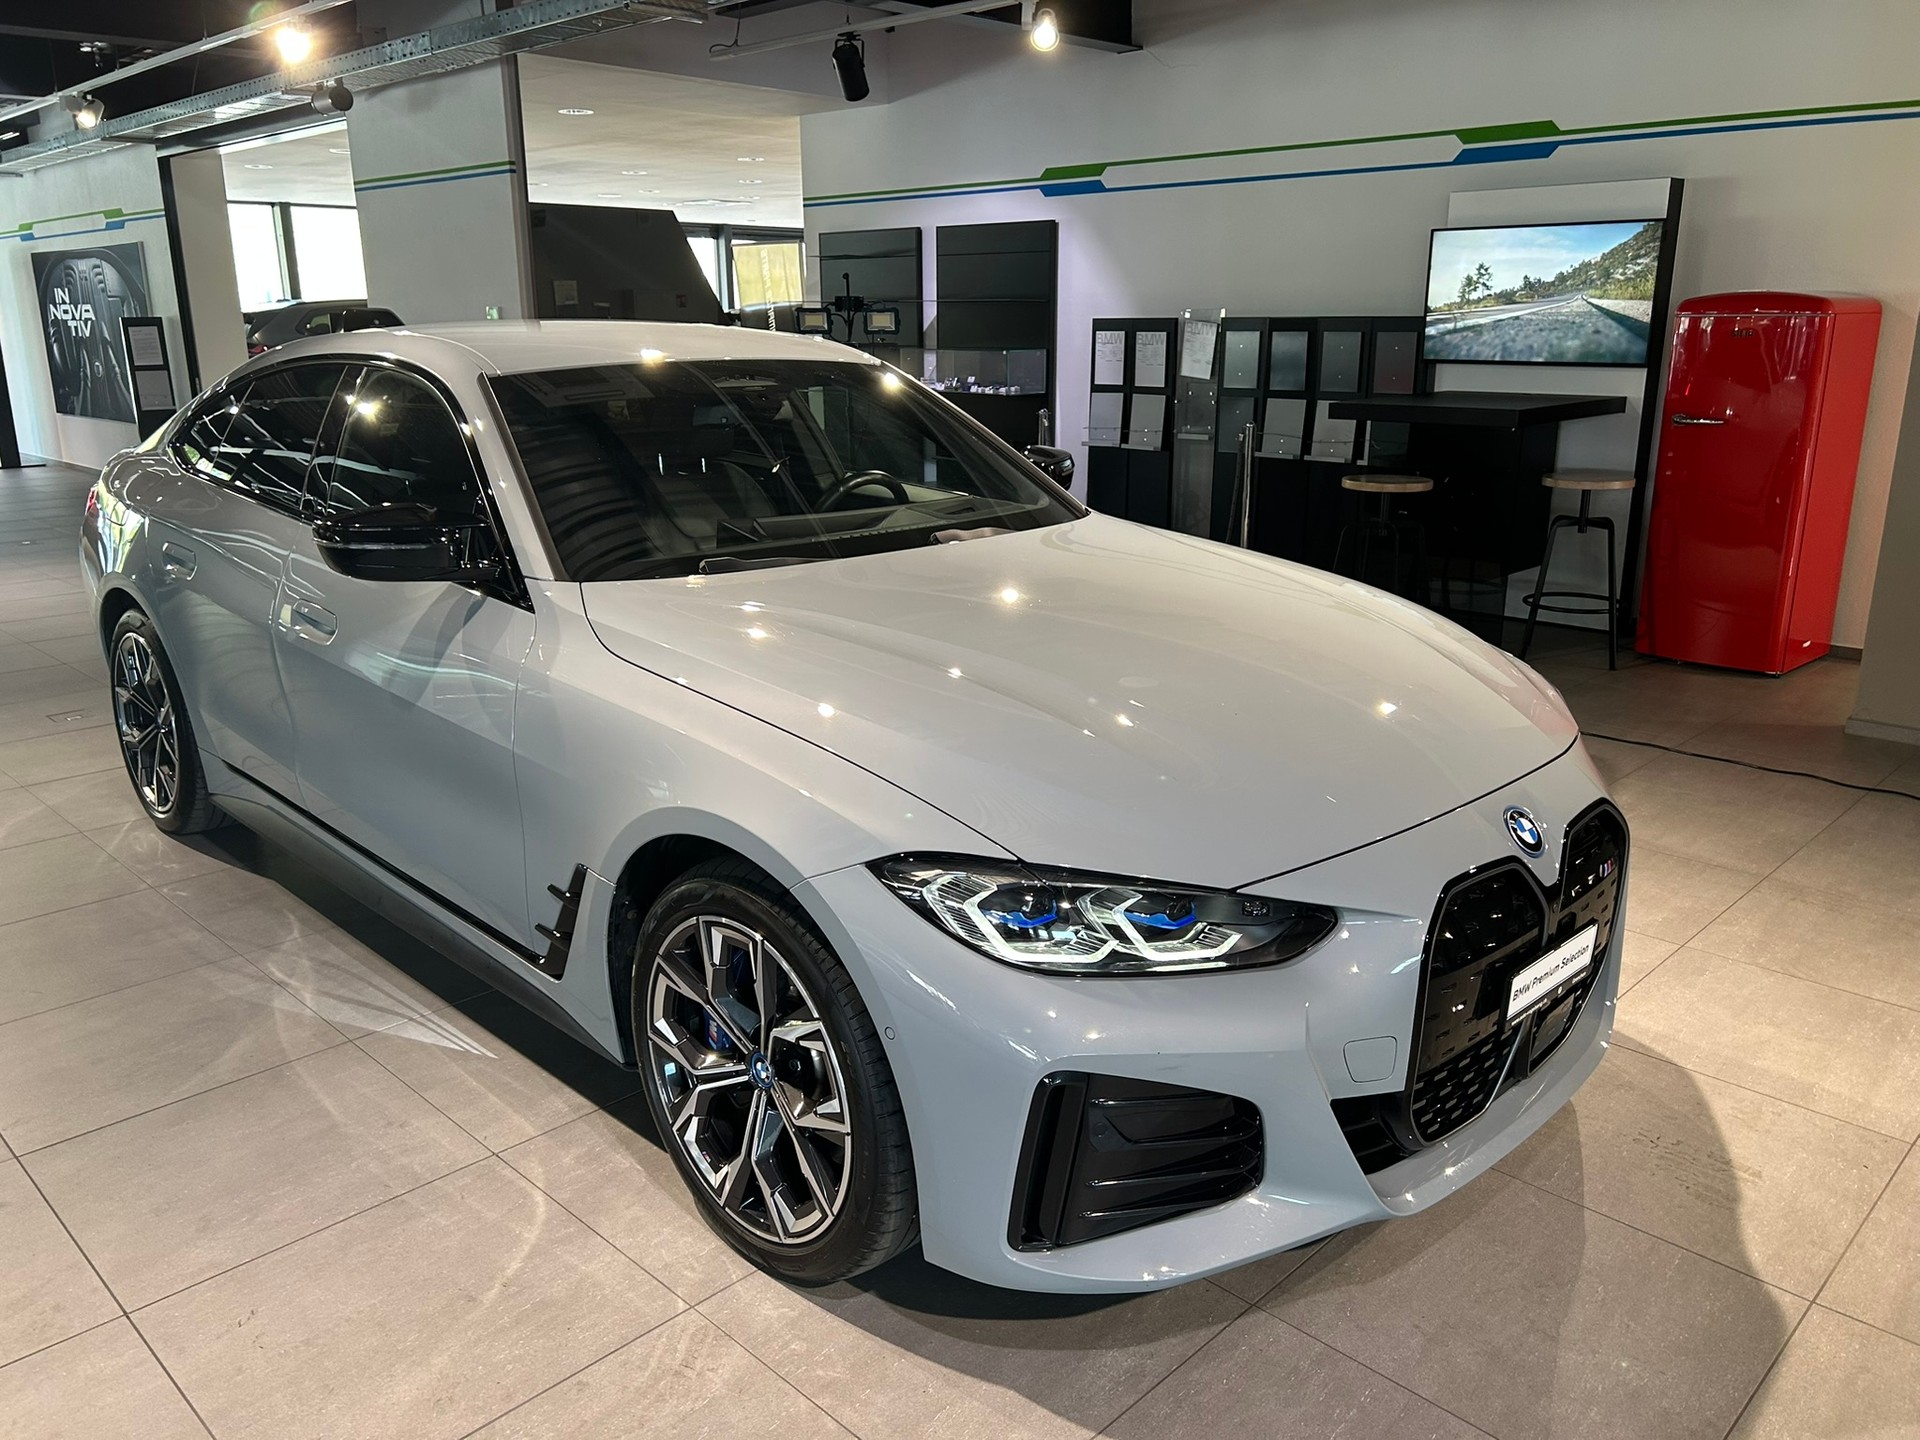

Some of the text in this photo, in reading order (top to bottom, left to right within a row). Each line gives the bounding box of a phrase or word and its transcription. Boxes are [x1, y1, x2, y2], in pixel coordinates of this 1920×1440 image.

[54, 288, 70, 304] IN
[49, 304, 96, 321] NOVA
[67, 320, 92, 337] TIV
[1186, 321, 1216, 336] BMW
[1096, 333, 1123, 345] BMW
[1137, 333, 1164, 346] BMW
[1513, 981, 1532, 1001] BMW
[1532, 964, 1560, 988] Premium
[1560, 944, 1589, 969] Selection
